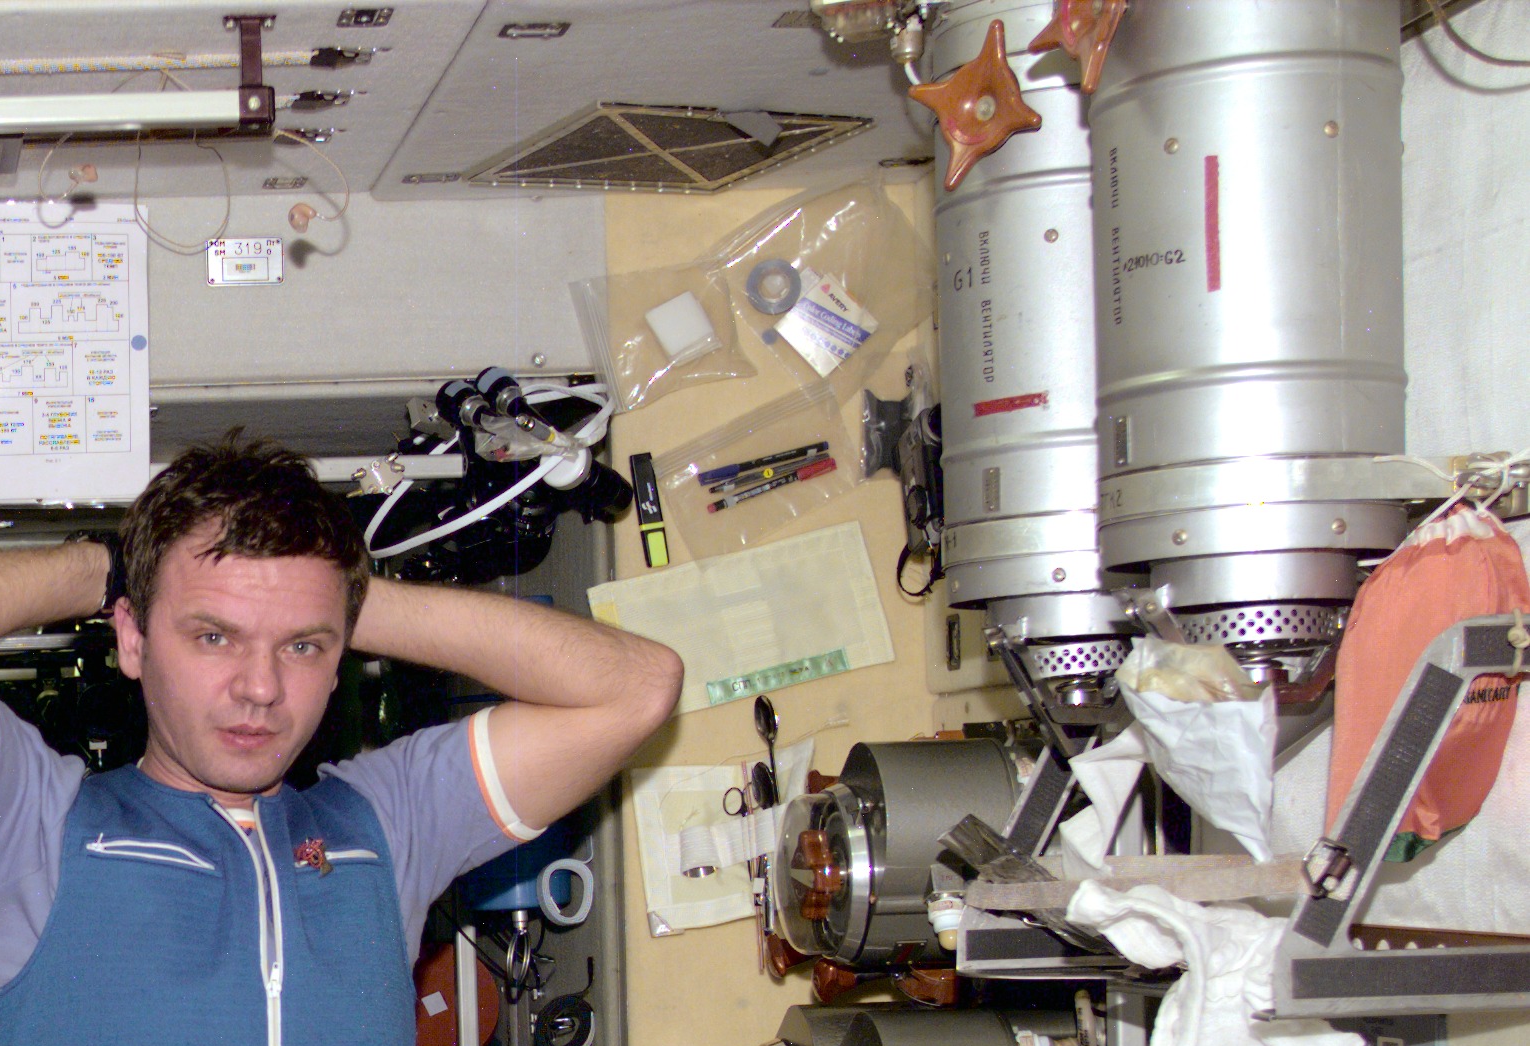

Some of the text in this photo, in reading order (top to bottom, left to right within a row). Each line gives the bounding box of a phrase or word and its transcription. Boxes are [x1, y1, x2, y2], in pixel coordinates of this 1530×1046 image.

[234, 241, 262, 255] 319
[953, 266, 973, 292] G1
[827, 292, 849, 313] AVERY
[978, 230, 995, 384] ВКЛЮЧИ ВЕНТИЛЯТОР
